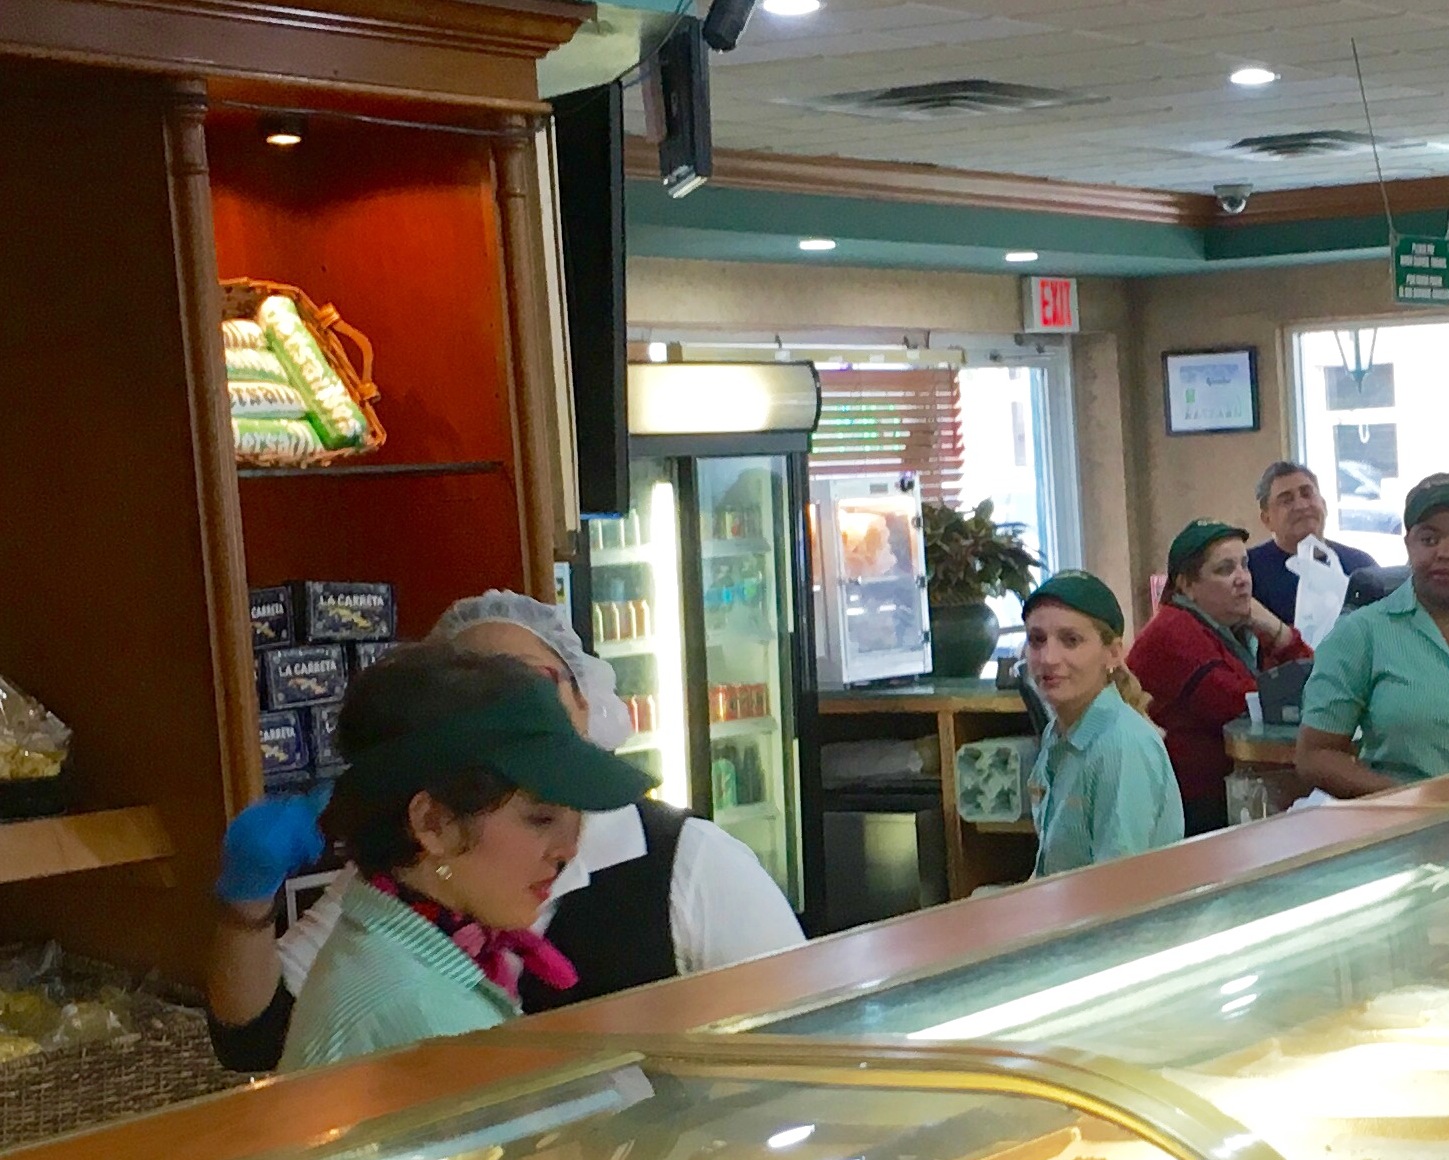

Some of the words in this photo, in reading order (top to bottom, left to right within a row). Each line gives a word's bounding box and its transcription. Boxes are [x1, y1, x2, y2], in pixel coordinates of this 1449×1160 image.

[1039, 279, 1072, 327] EXIT
[338, 594, 384, 607] CARRETA
[294, 660, 337, 676] CARRETA
